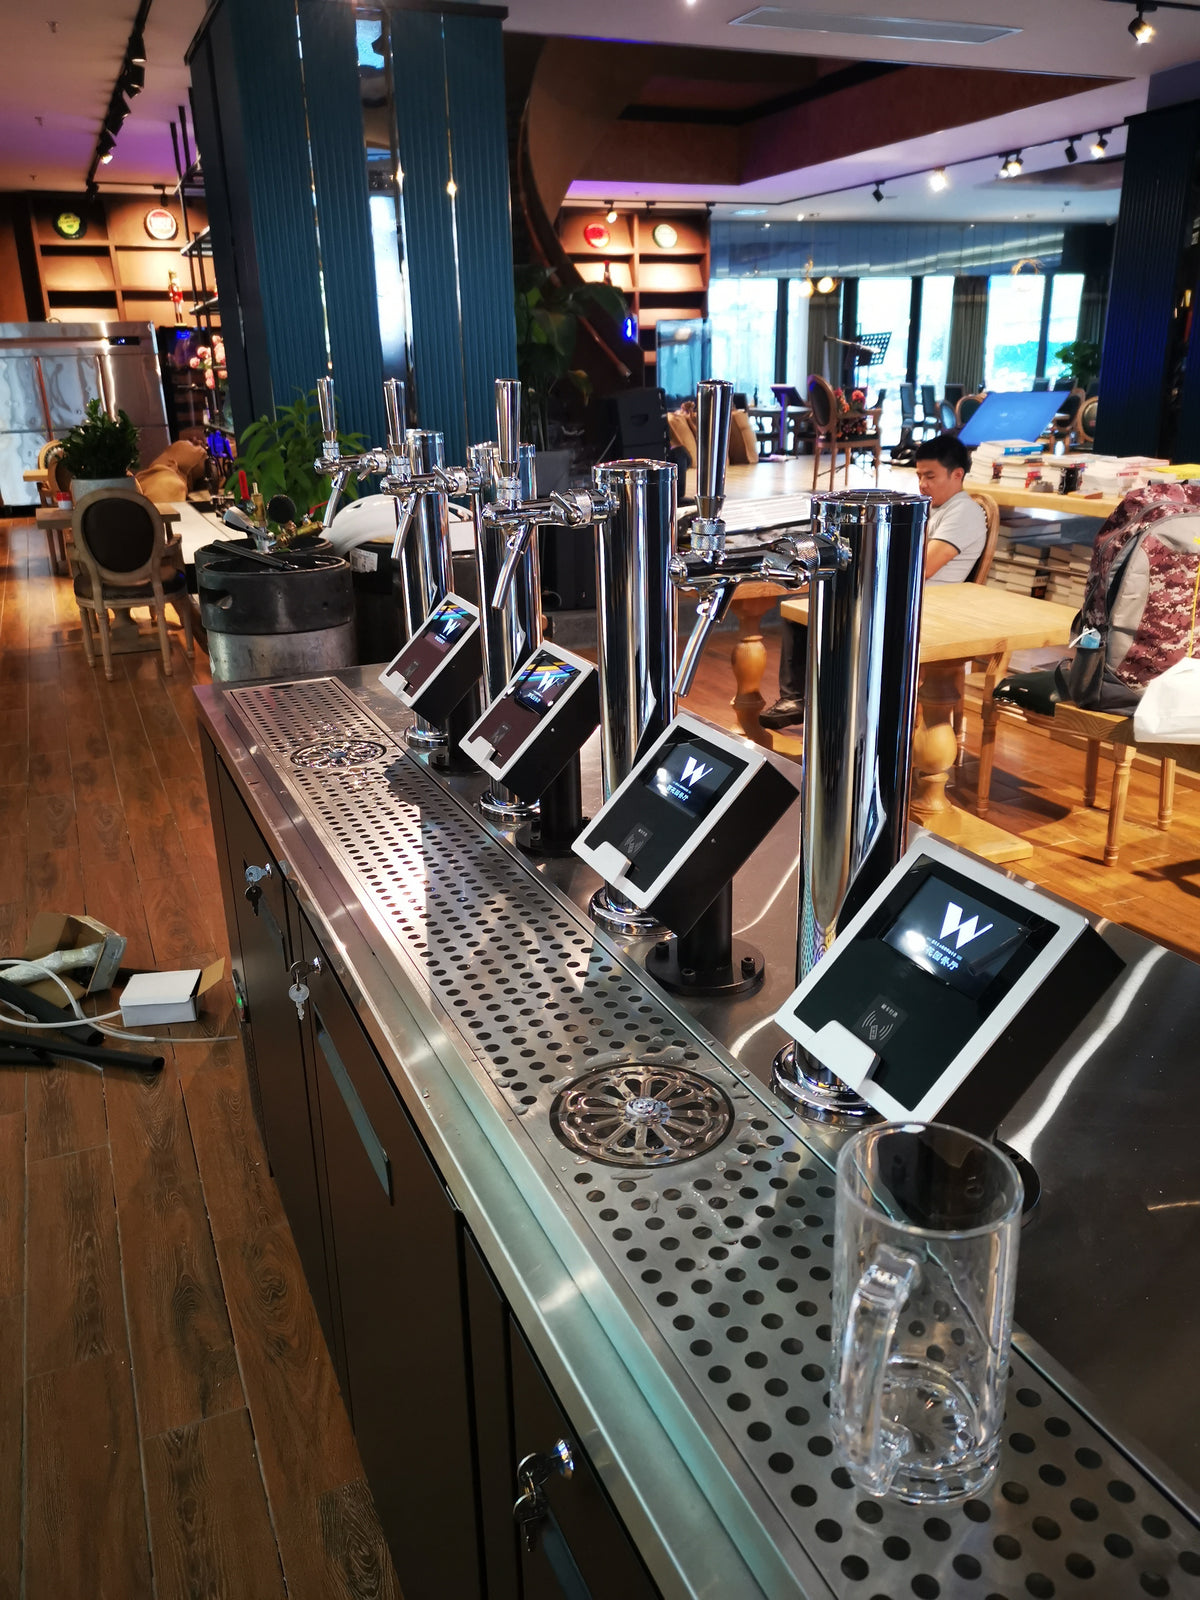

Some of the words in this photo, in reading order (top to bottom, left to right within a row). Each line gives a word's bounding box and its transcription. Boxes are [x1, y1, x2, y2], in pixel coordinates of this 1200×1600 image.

[442, 618, 461, 636] W
[537, 671, 560, 693] W
[680, 756, 714, 787] W
[939, 901, 994, 950] W
